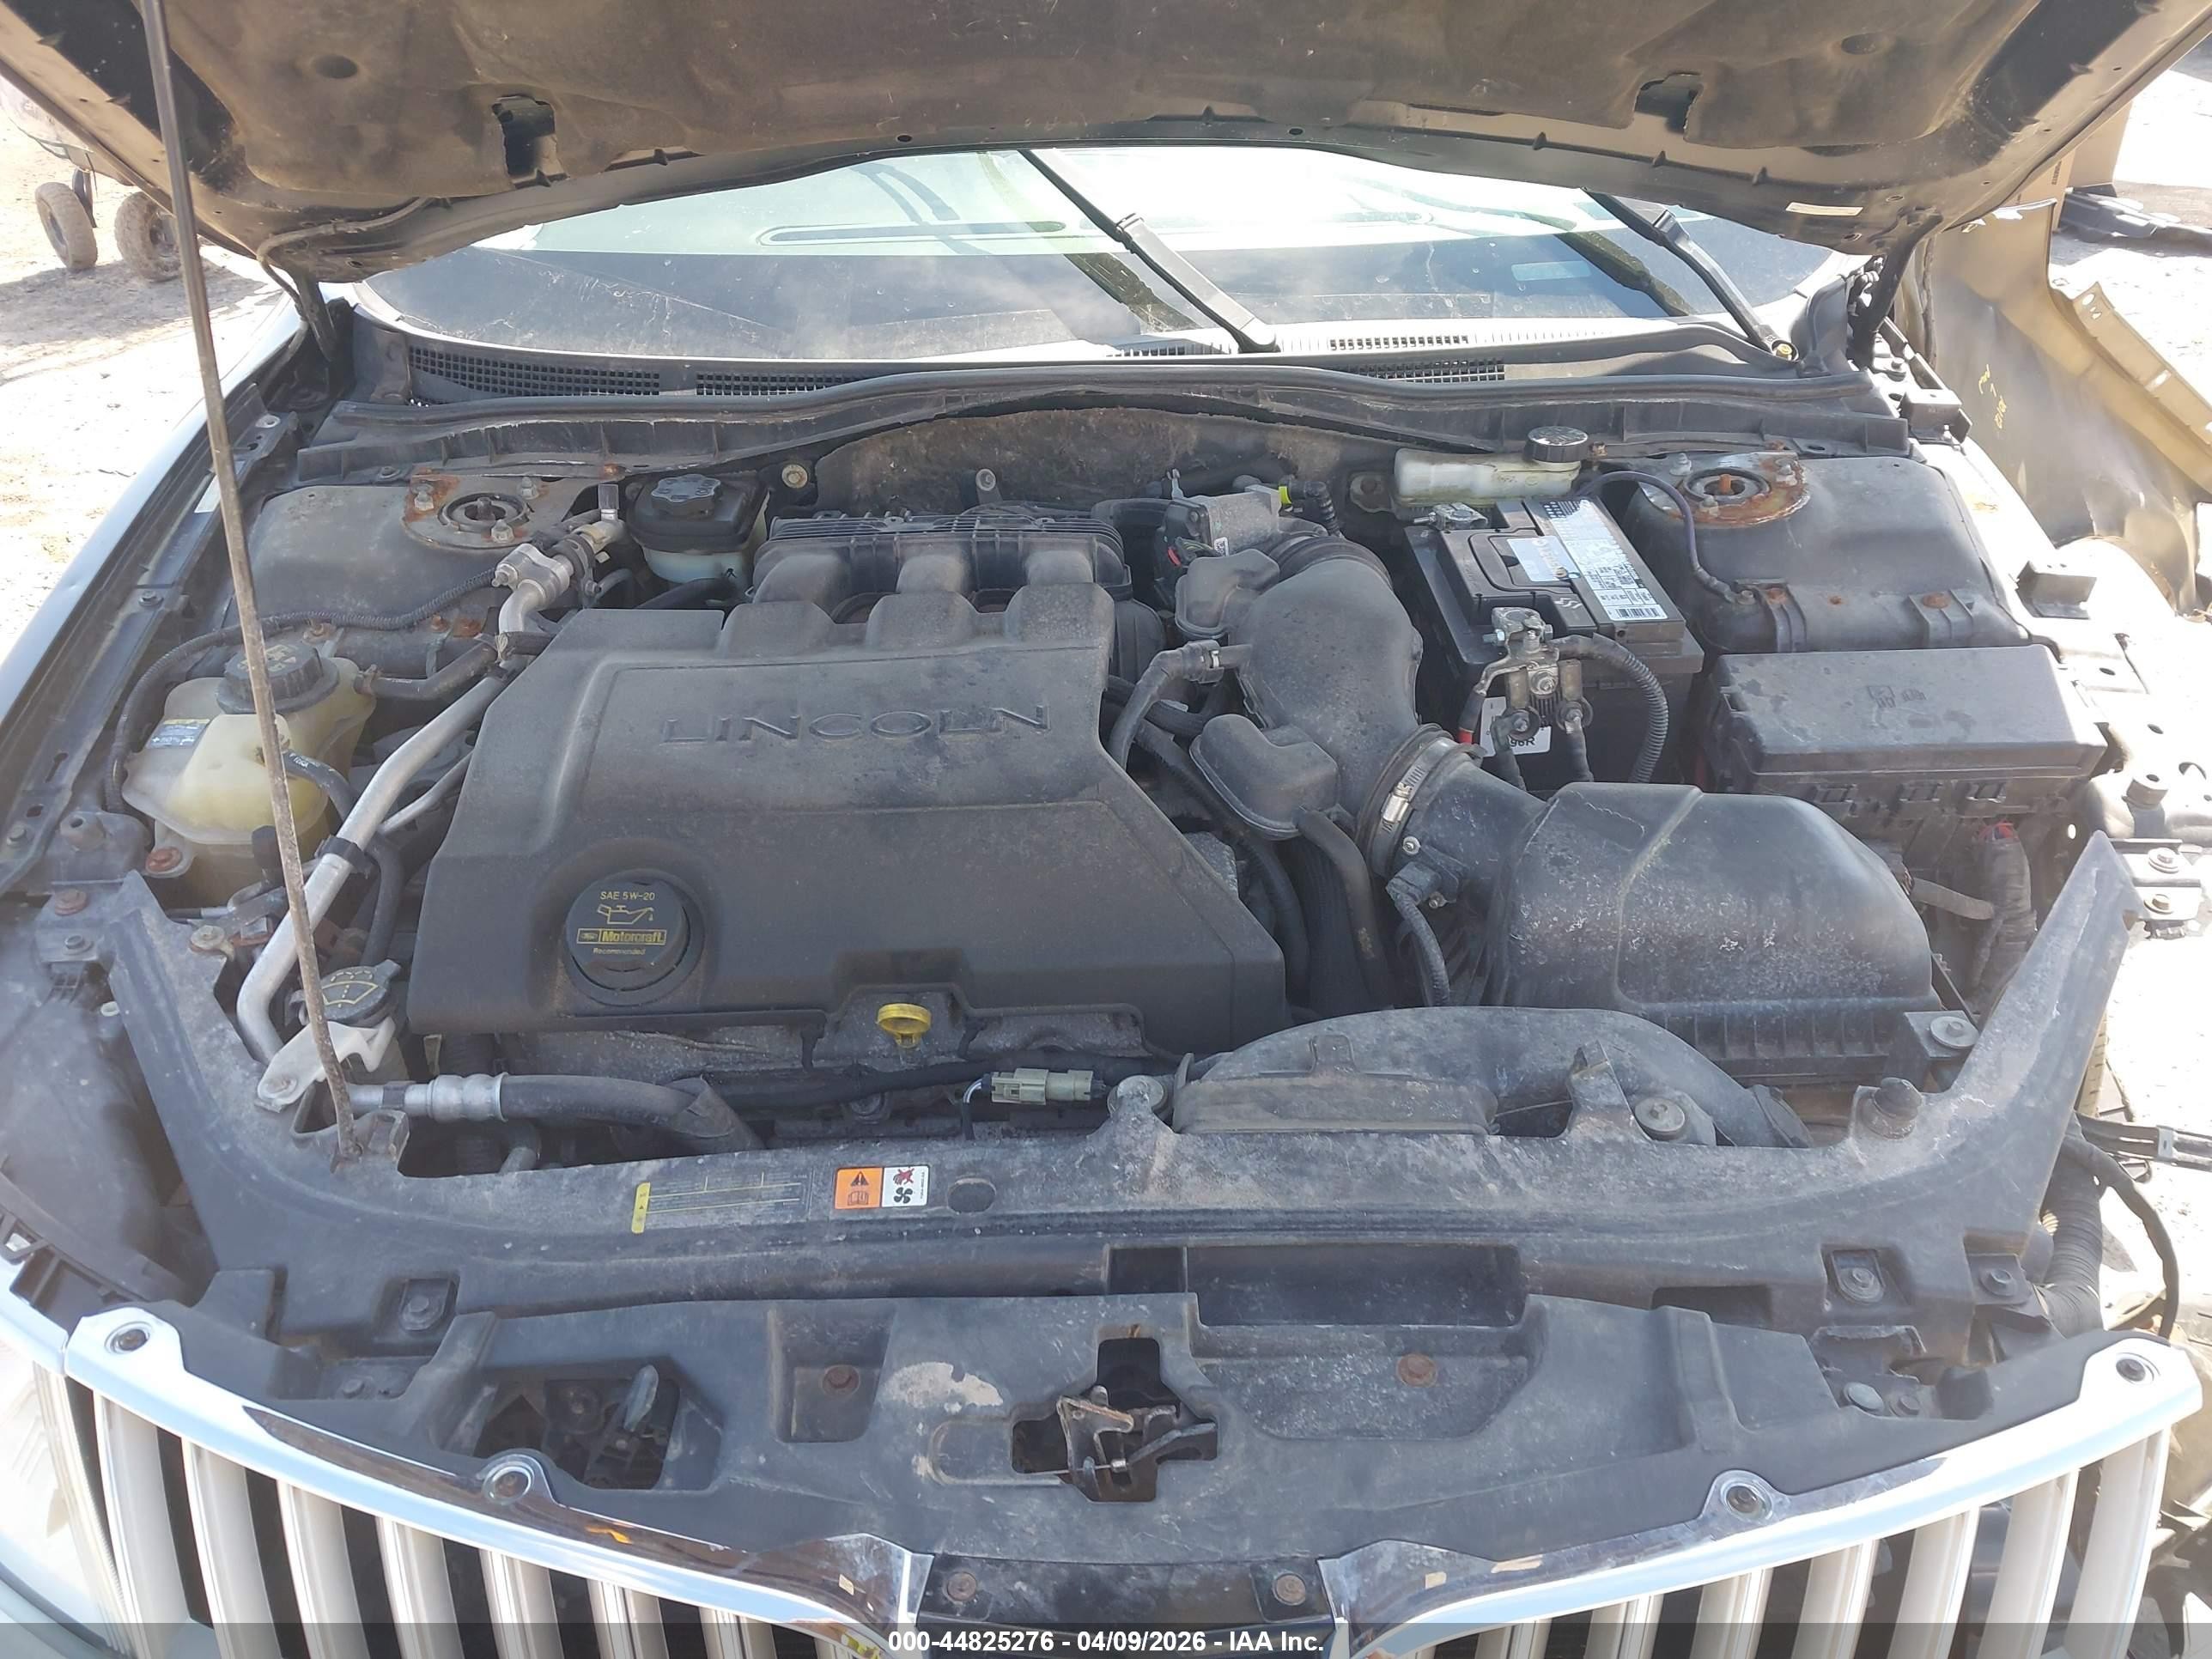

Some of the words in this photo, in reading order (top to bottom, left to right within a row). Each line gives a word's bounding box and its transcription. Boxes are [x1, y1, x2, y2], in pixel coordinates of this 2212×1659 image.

[660, 704, 1051, 744] LINCOLN
[599, 891, 620, 900] SAE
[622, 891, 655, 901] 5W-20
[603, 931, 661, 943] Motorcraft
